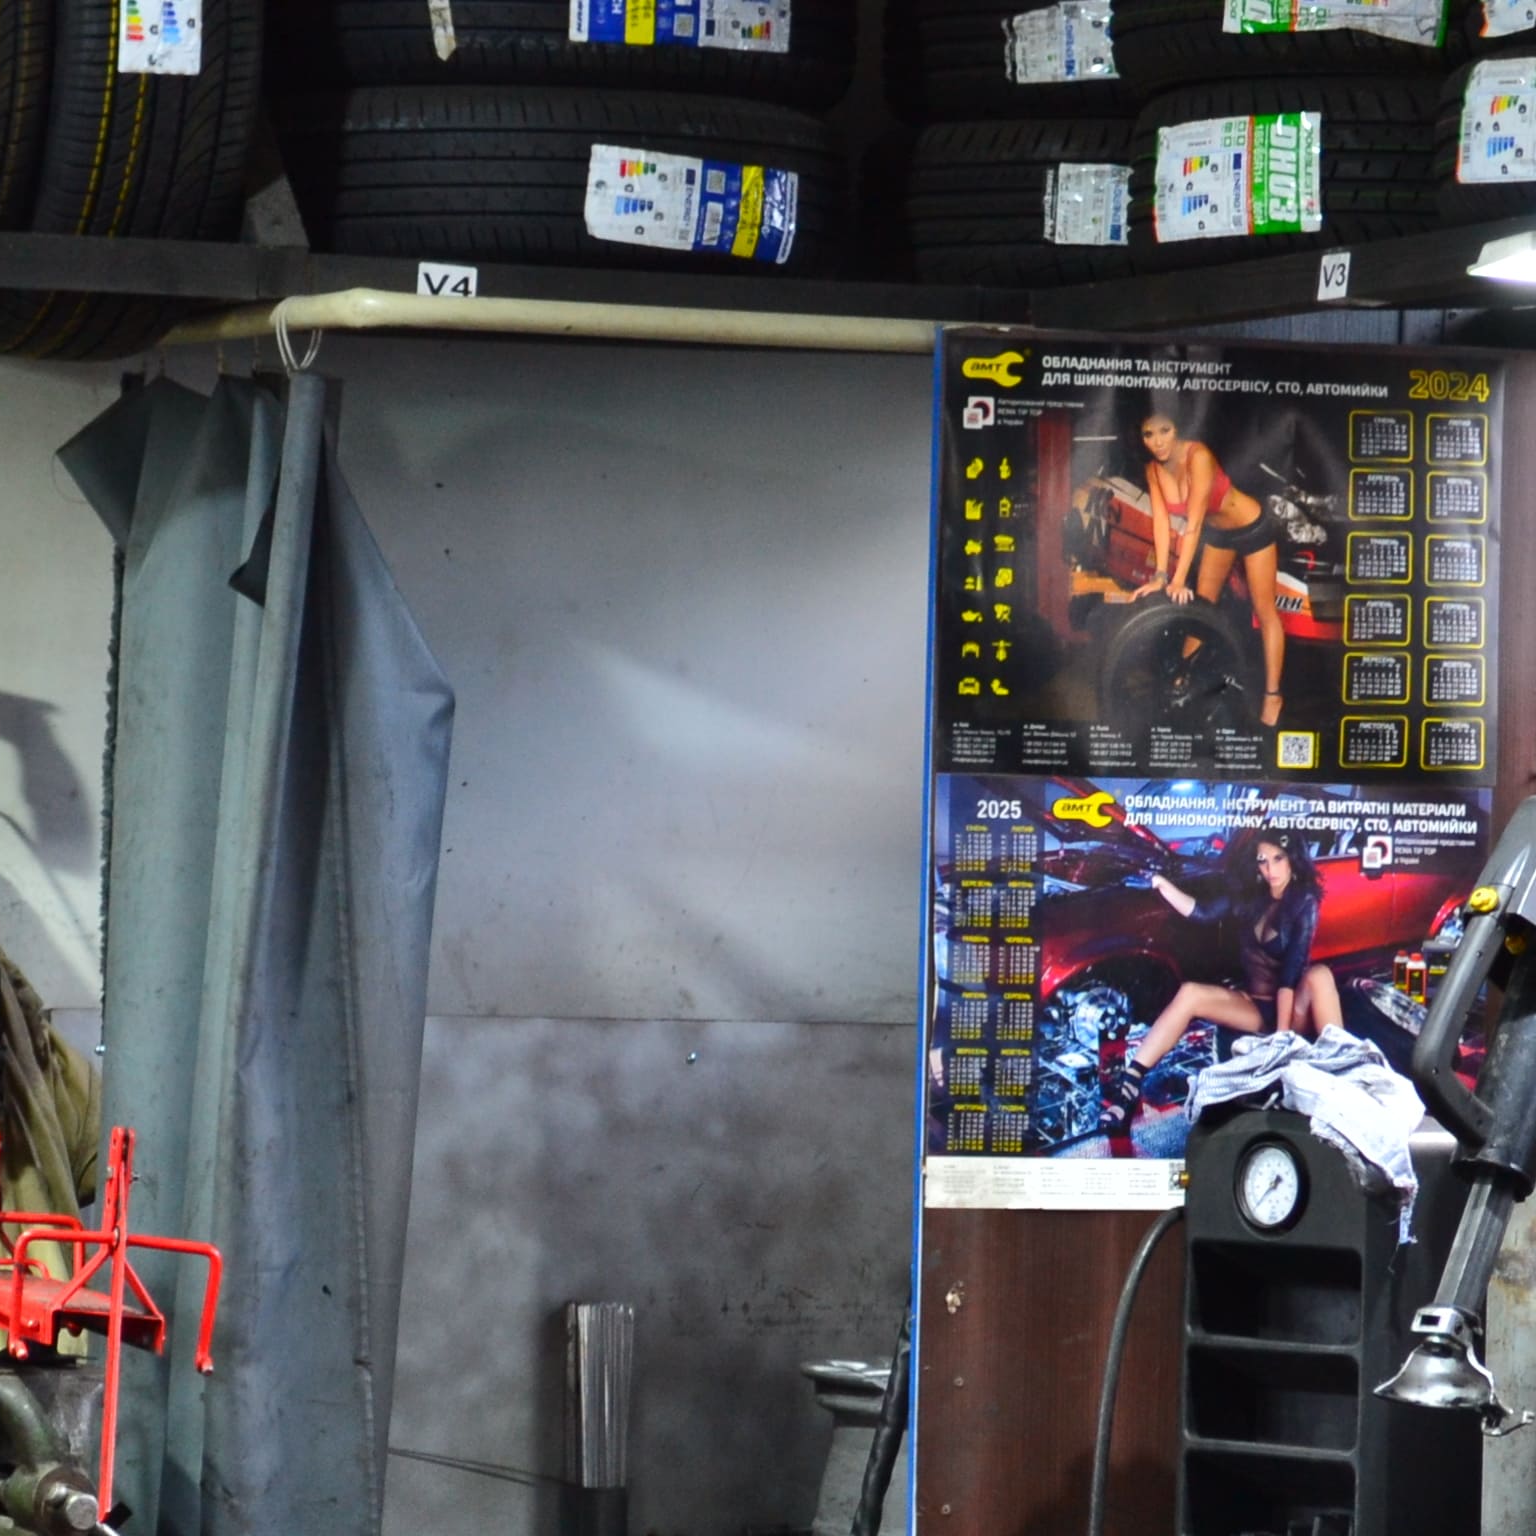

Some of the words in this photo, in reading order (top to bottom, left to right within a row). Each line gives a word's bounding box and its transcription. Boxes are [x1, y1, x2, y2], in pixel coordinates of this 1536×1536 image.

[1268, 122, 1298, 223] DH03
[423, 273, 473, 298] V4
[1322, 263, 1346, 289] V3
[1041, 355, 1132, 372] ОБЛАДНАННЯ
[1134, 359, 1150, 372] ТА
[1152, 361, 1232, 375] ІНСТРУМЕНТ
[1041, 372, 1071, 387] ДЛЯ
[1074, 374, 1181, 391] ШИНОМОНТАЖУ,
[1182, 377, 1272, 395] АВТОСЕРВІСУ,
[1275, 381, 1304, 396] СТО,
[1306, 382, 1388, 398] АВТОМИЙКИ
[1409, 370, 1490, 403] 2024
[976, 800, 1022, 819] 2025
[1124, 795, 1219, 811] ОБЛАДНАННЯ,
[1222, 797, 1305, 812] ІНСТРУМЕНТ
[1309, 799, 1326, 813] ТА
[1328, 800, 1390, 816] ВИТРАТНІ
[1392, 802, 1467, 817] МАТЕРІАЛИ
[1123, 812, 1153, 827] ДЛЯ
[1155, 813, 1267, 830] ШИНОМОНТАЖУ,
[1268, 815, 1362, 832] АВТОСЕРВІСУ,
[1364, 819, 1392, 834] СТО,
[1393, 818, 1478, 834] АВТОМИЙКИ
